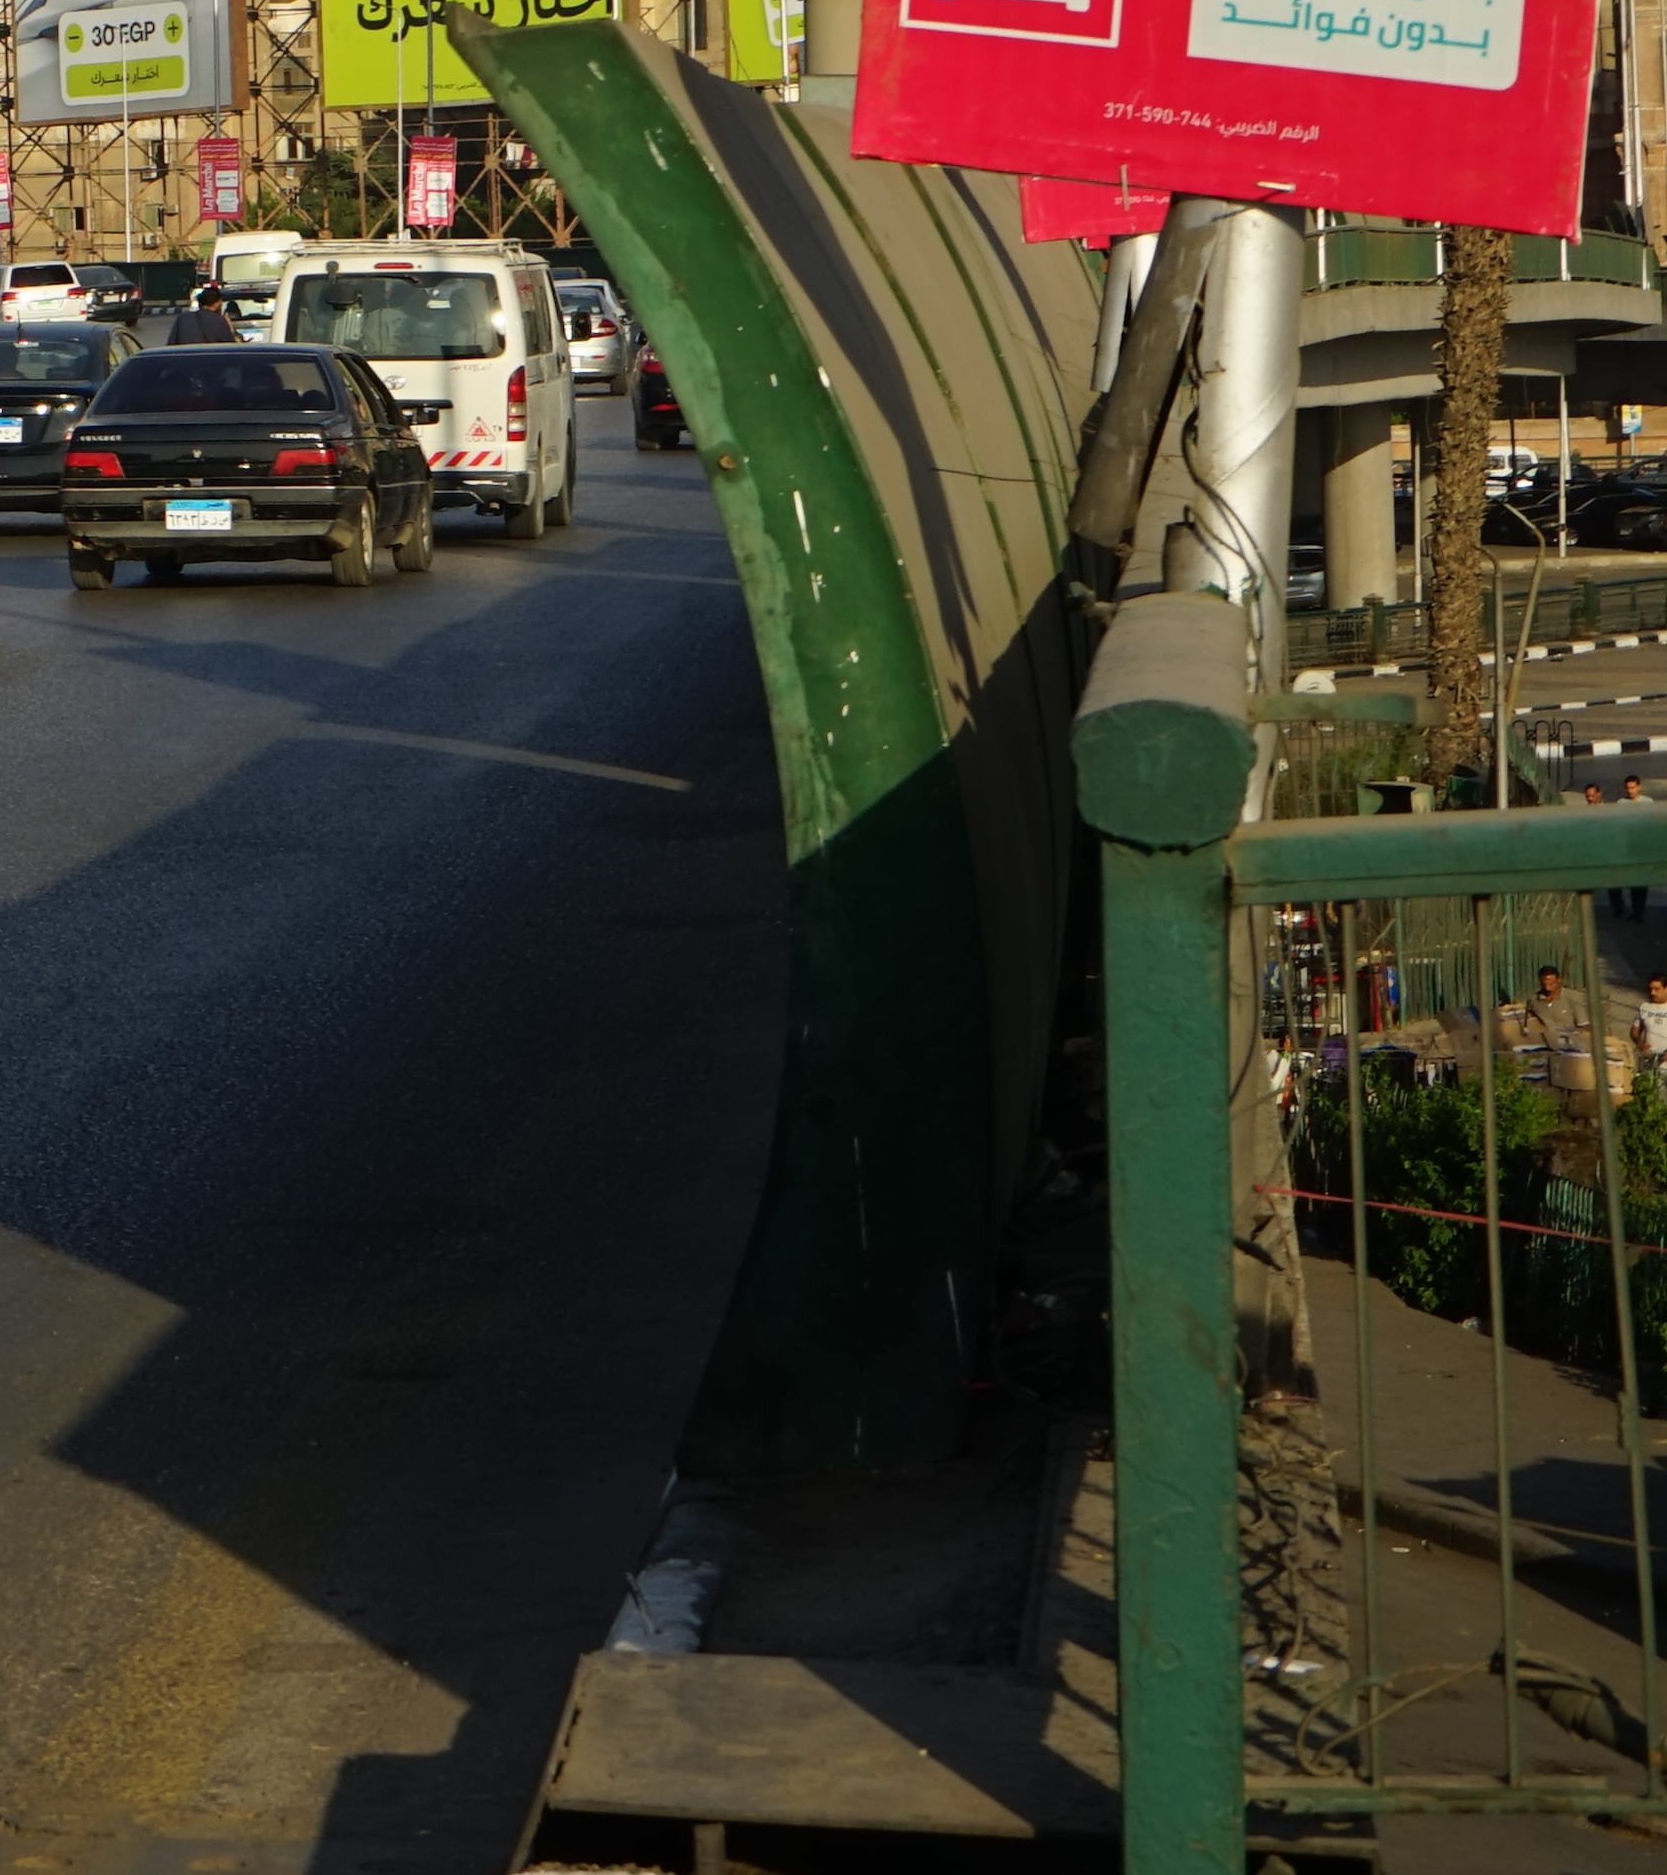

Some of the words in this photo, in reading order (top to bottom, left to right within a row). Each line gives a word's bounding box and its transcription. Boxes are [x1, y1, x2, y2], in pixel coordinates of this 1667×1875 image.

[91, 23, 115, 47] 30
[119, 20, 156, 44] EGP
[1378, 14, 1489, 56] بدون
[1103, 101, 1212, 129] 371-590-744
